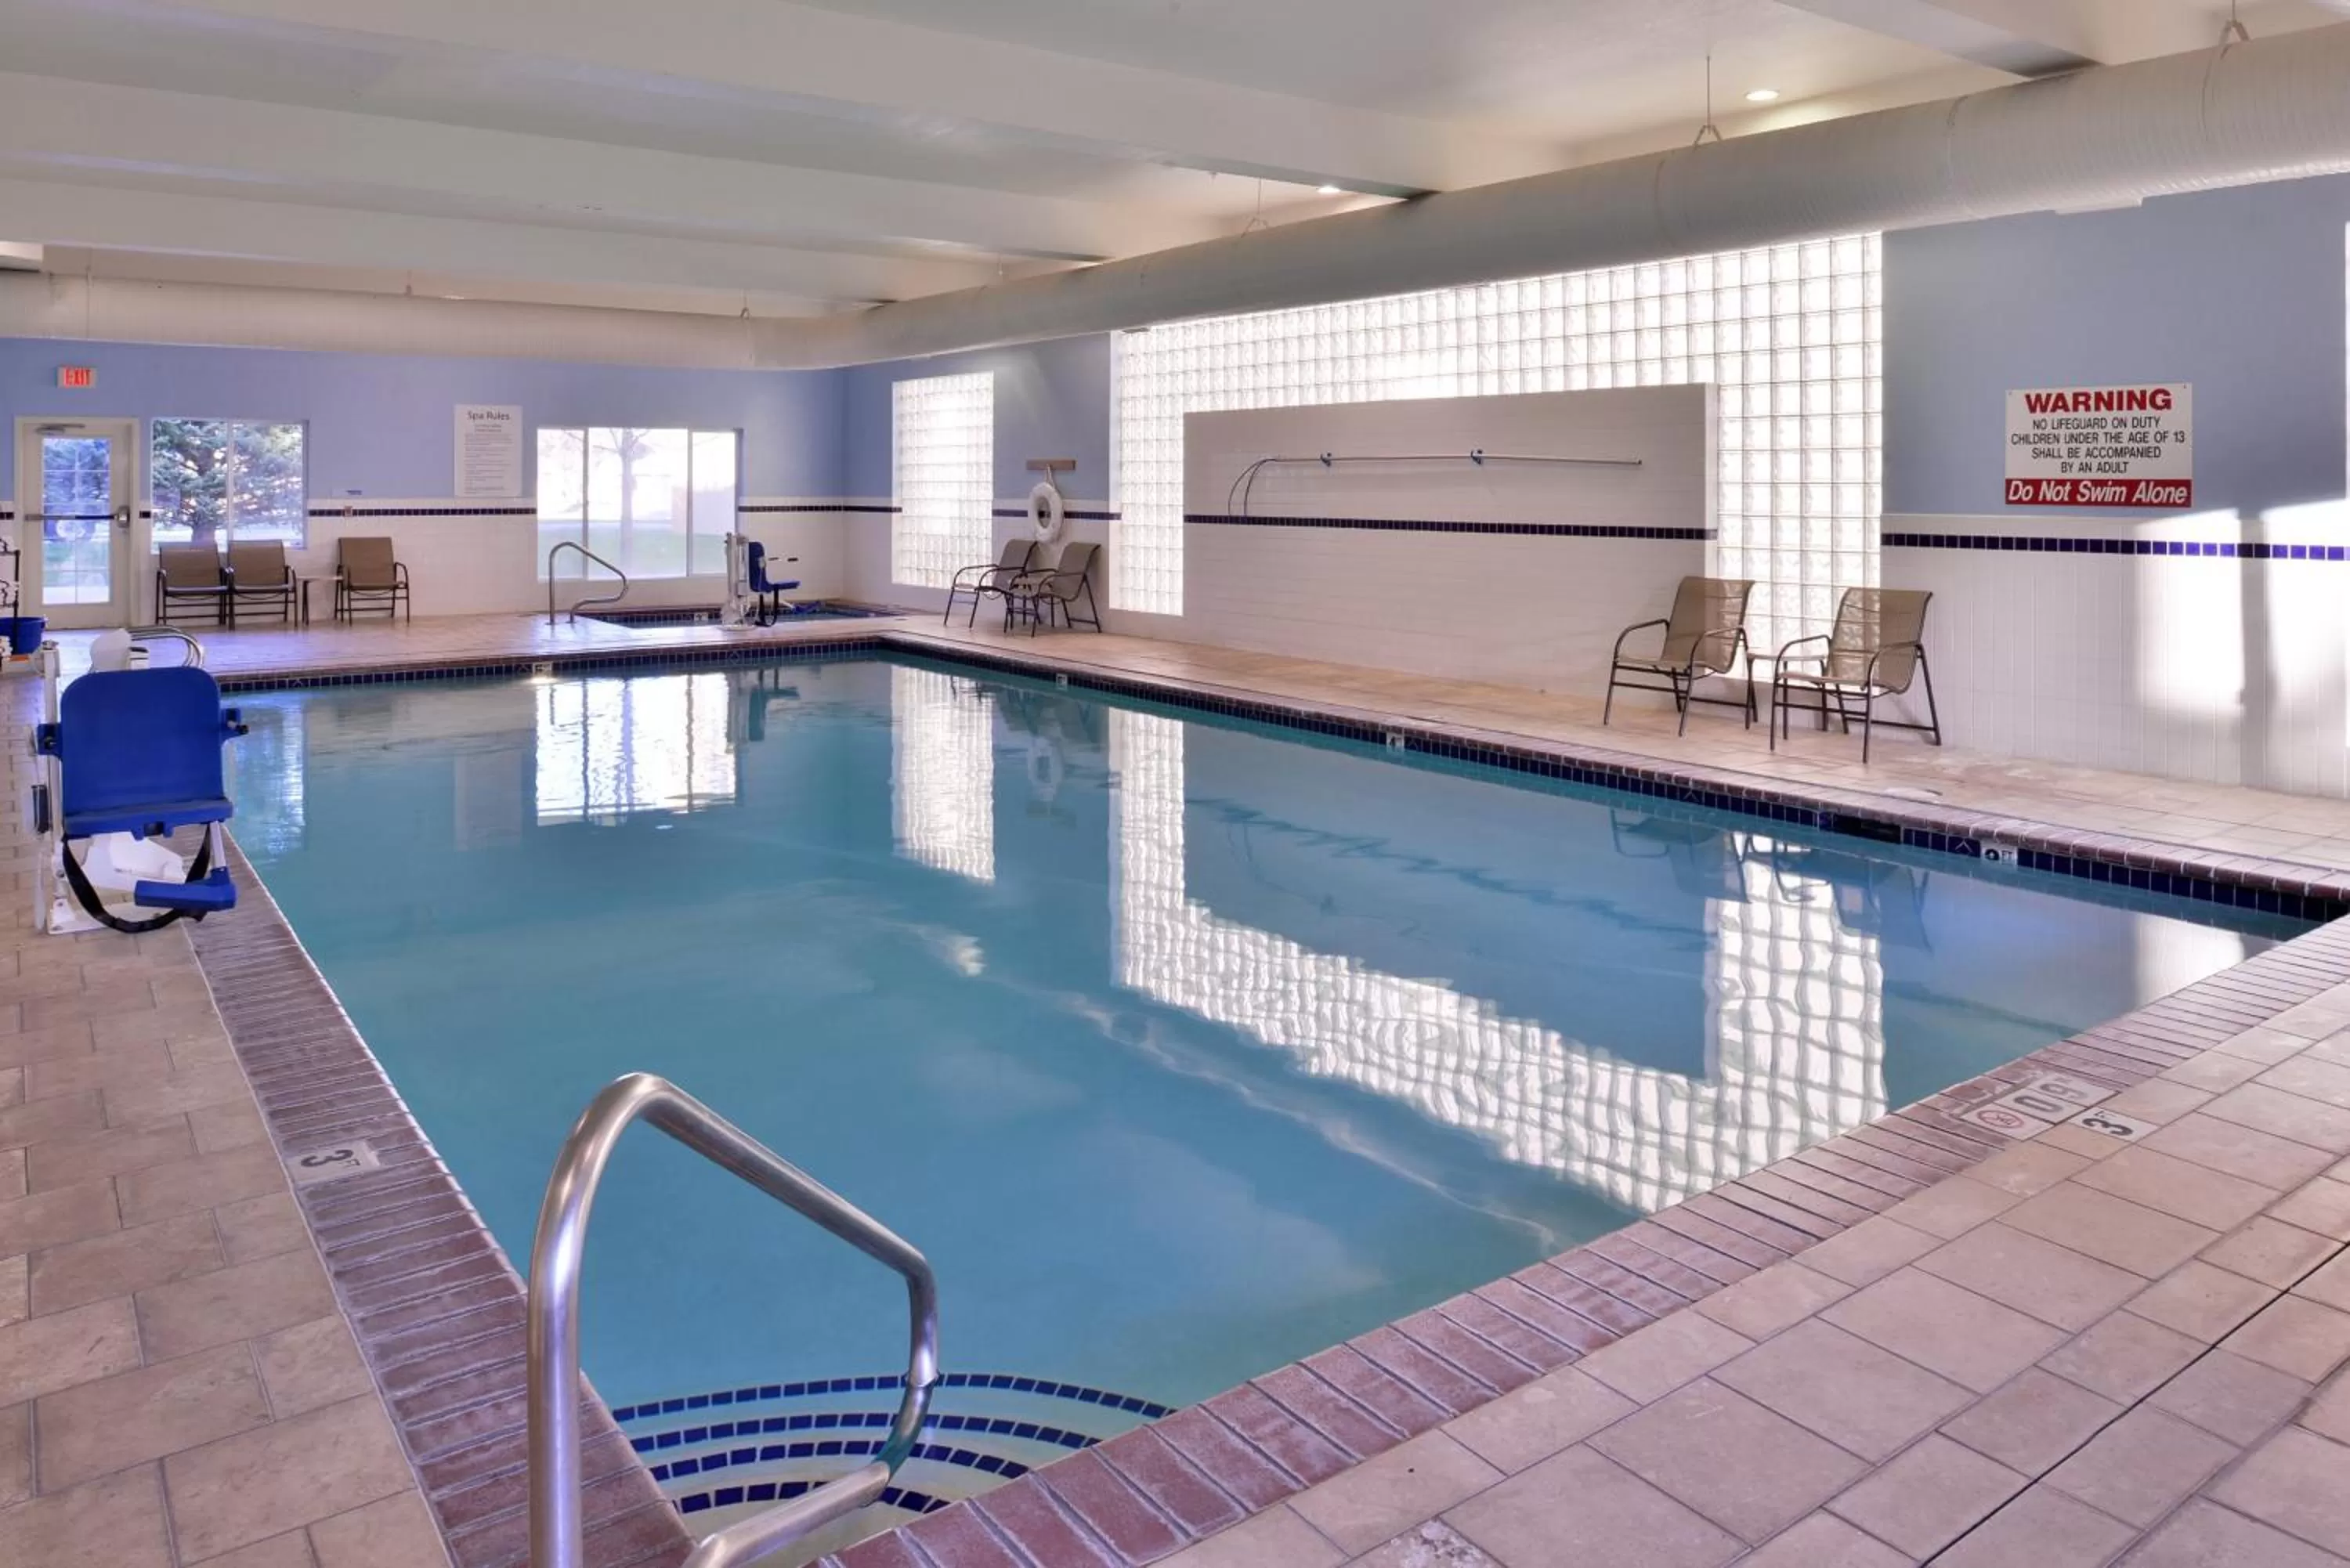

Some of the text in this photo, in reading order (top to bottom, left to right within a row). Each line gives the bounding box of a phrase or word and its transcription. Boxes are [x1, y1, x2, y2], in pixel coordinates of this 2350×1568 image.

[65, 369, 92, 386] EXIT
[2025, 388, 2172, 414] WARNING
[468, 410, 510, 421] Spa Rules
[2033, 416, 2160, 430] NO LIFEGUARD ON DUTY
[2011, 430, 2185, 446] CHILDREN UNDER THE AGE OF 13
[2031, 446, 2161, 459] SHALL BE ACCOMPANIED
[2061, 461, 2129, 474] BY AN ADULT
[2008, 480, 2188, 504] Do Not Swim Alone
[2082, 1118, 2134, 1136] 3
[300, 1149, 354, 1167] 3
